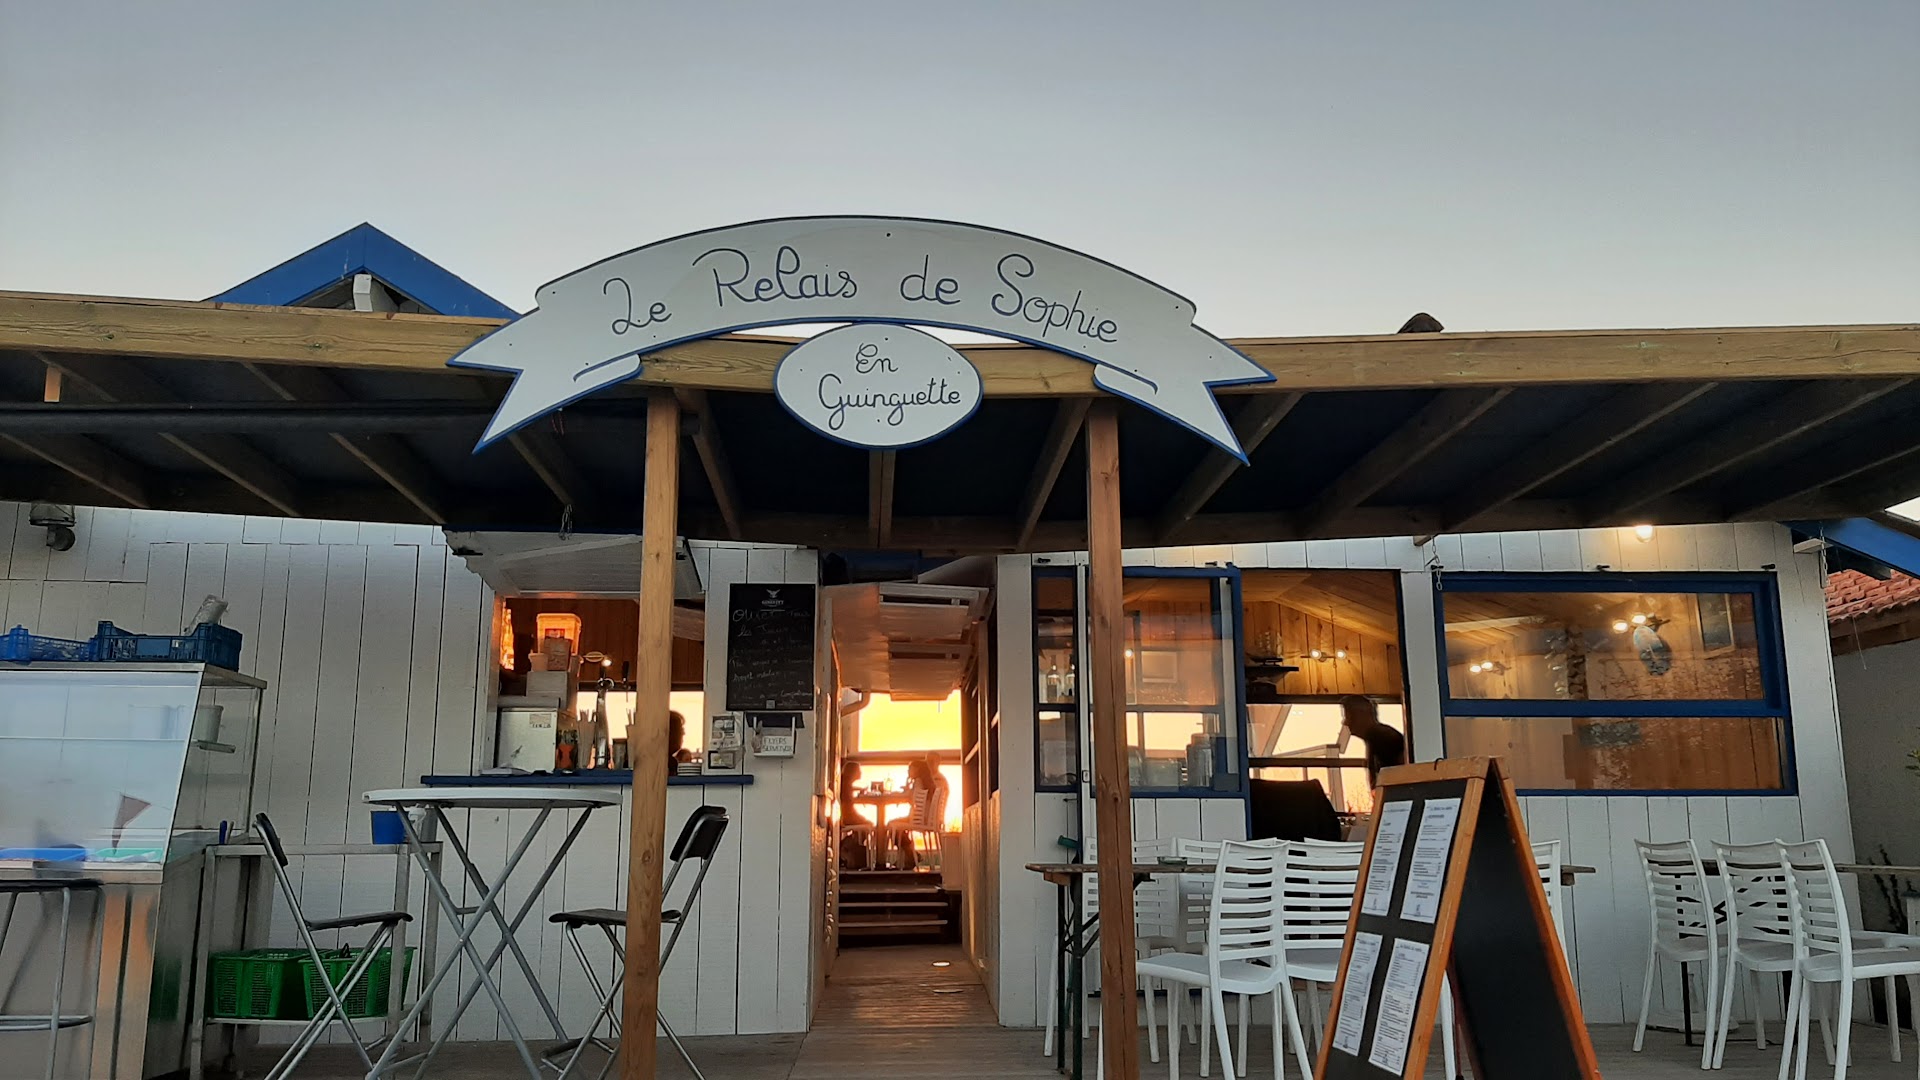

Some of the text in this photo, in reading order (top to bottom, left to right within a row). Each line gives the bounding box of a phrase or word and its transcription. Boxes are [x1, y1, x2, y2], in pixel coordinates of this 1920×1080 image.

[603, 246, 1118, 343] Le Relais de Sophie
[856, 343, 899, 374] En
[819, 374, 962, 432] Guinguette
